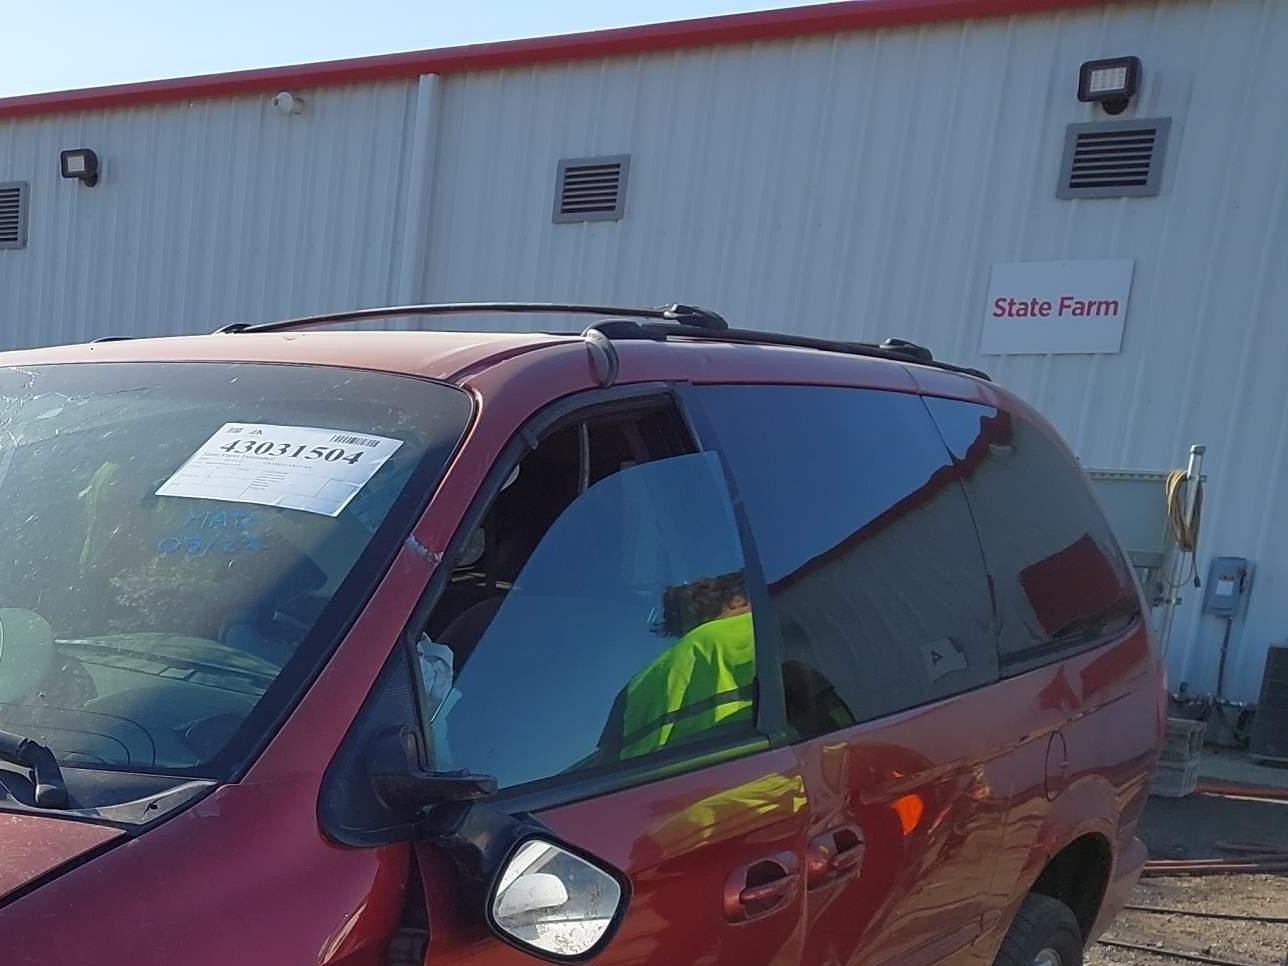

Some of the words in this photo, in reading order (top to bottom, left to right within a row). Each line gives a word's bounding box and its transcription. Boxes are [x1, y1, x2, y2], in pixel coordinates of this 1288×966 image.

[992, 297, 1052, 318] State
[1058, 296, 1119, 317] Farm
[220, 439, 365, 465] 43031504
